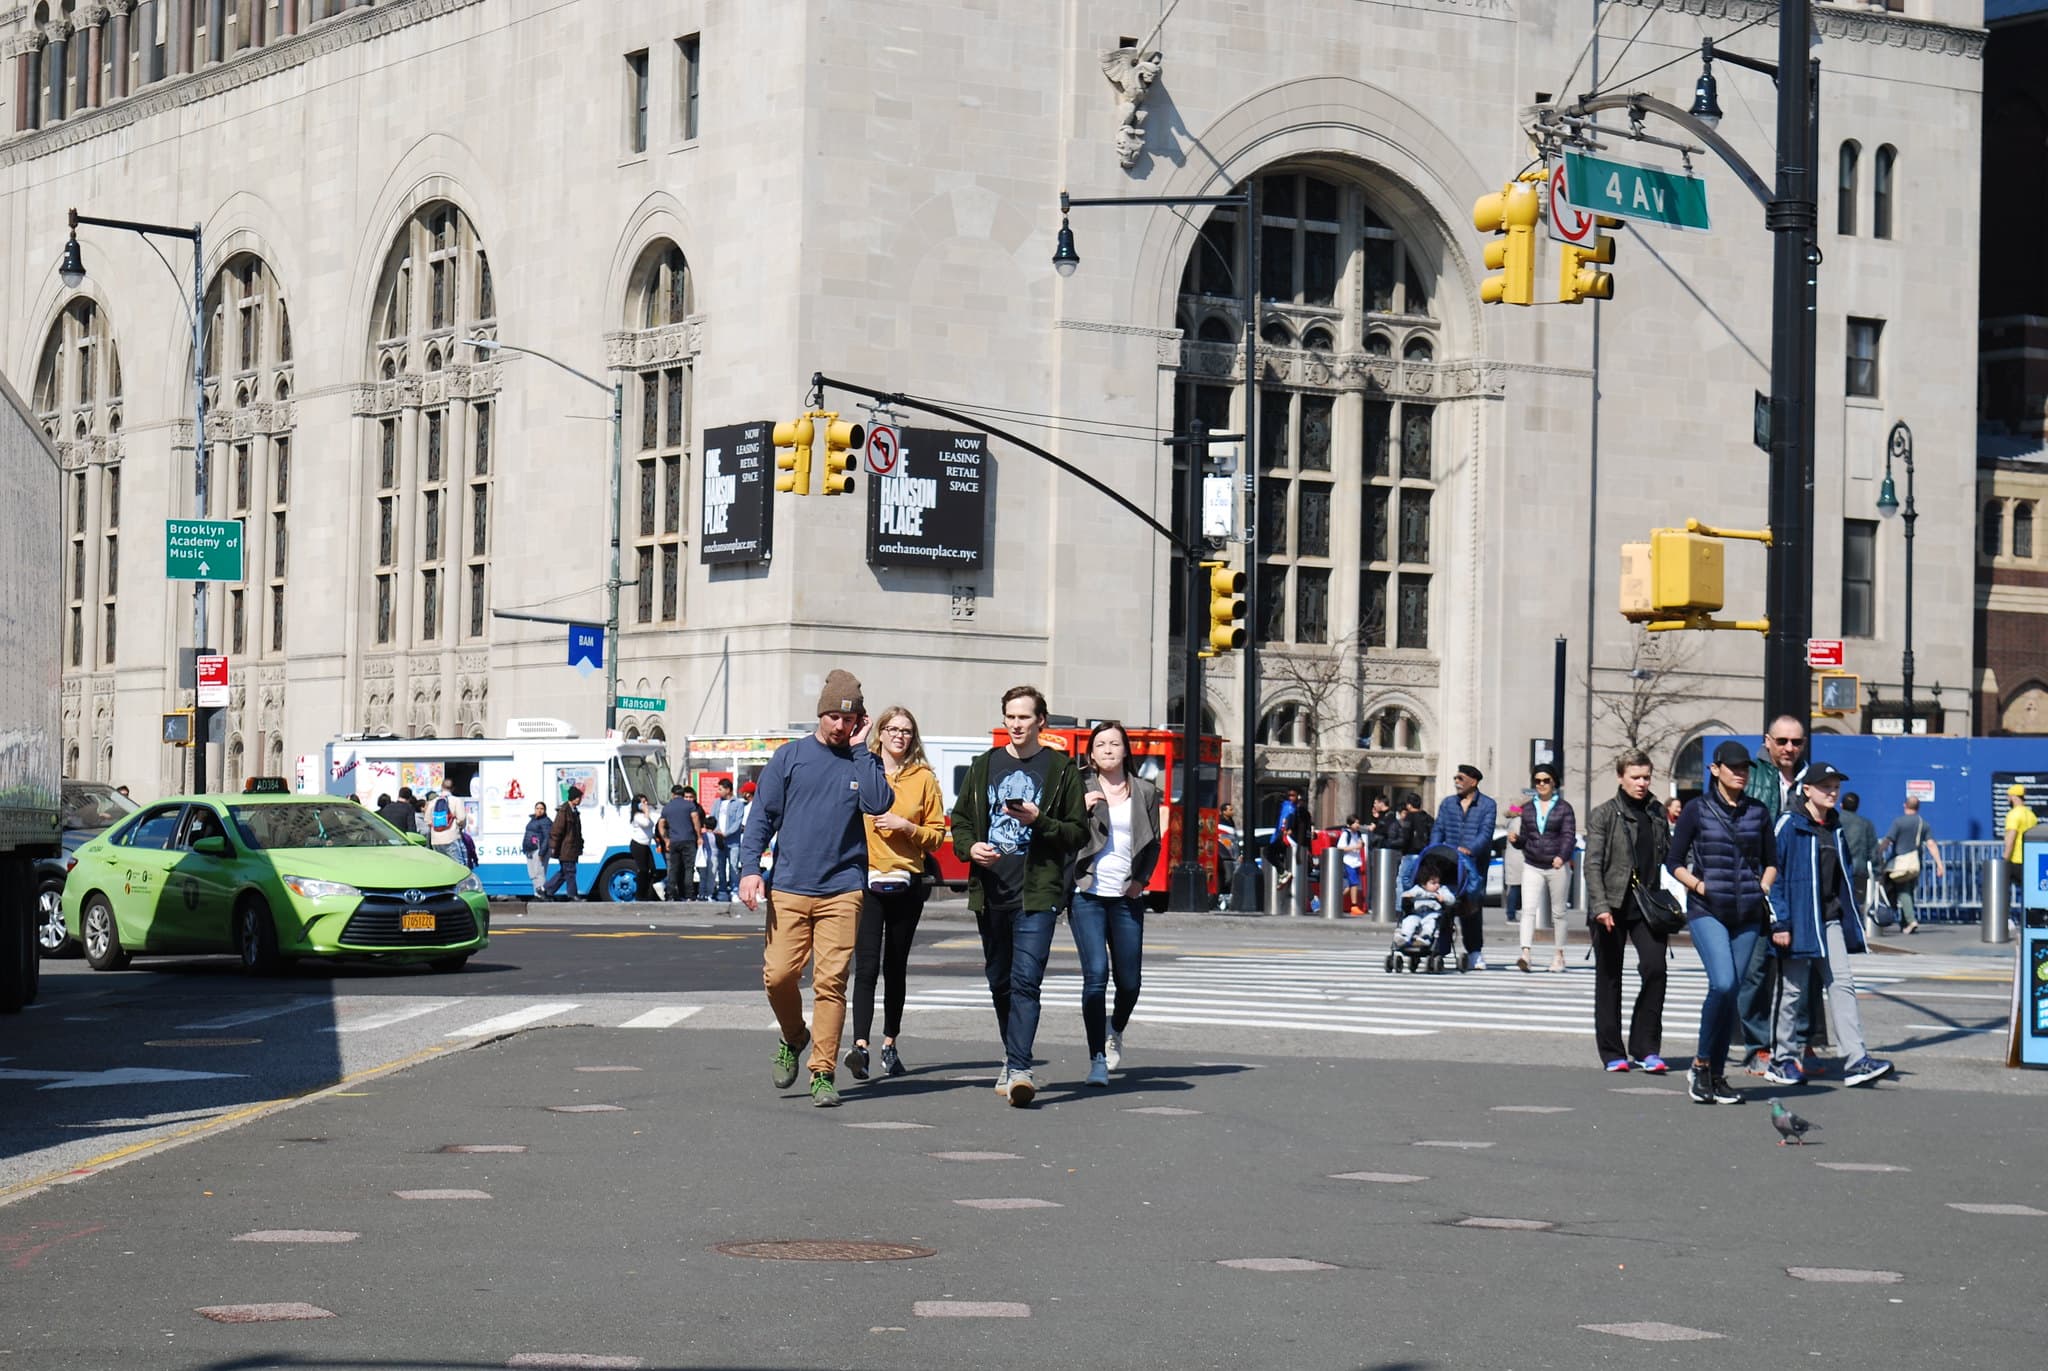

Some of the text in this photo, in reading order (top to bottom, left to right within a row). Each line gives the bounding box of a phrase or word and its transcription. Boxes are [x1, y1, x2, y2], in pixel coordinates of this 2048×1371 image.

[1606, 171, 1664, 213] 4 Av
[744, 428, 760, 440] NOW
[736, 442, 759, 455] LEASING
[955, 438, 980, 450] NOW
[706, 448, 721, 478] ONE
[740, 457, 759, 469] RETAIL
[939, 451, 980, 464] LEASING
[741, 471, 759, 483] SPACE
[946, 466, 979, 478] RETAIL
[705, 474, 736, 506] HANSON
[880, 477, 937, 509] HANSON
[949, 481, 979, 493] SPACE
[704, 503, 728, 535] PLACE
[879, 504, 923, 536] PLACE
[170, 524, 225, 537] Brooklyn
[170, 536, 238, 549] Academy of
[703, 538, 758, 554] onehansonplace.nyc
[170, 548, 204, 558] Music
[879, 542, 977, 562] onehansonplace.nyc
[578, 635, 594, 647] BAM
[622, 698, 654, 709] Hanson
[1879, 719, 1920, 728] SUBY
